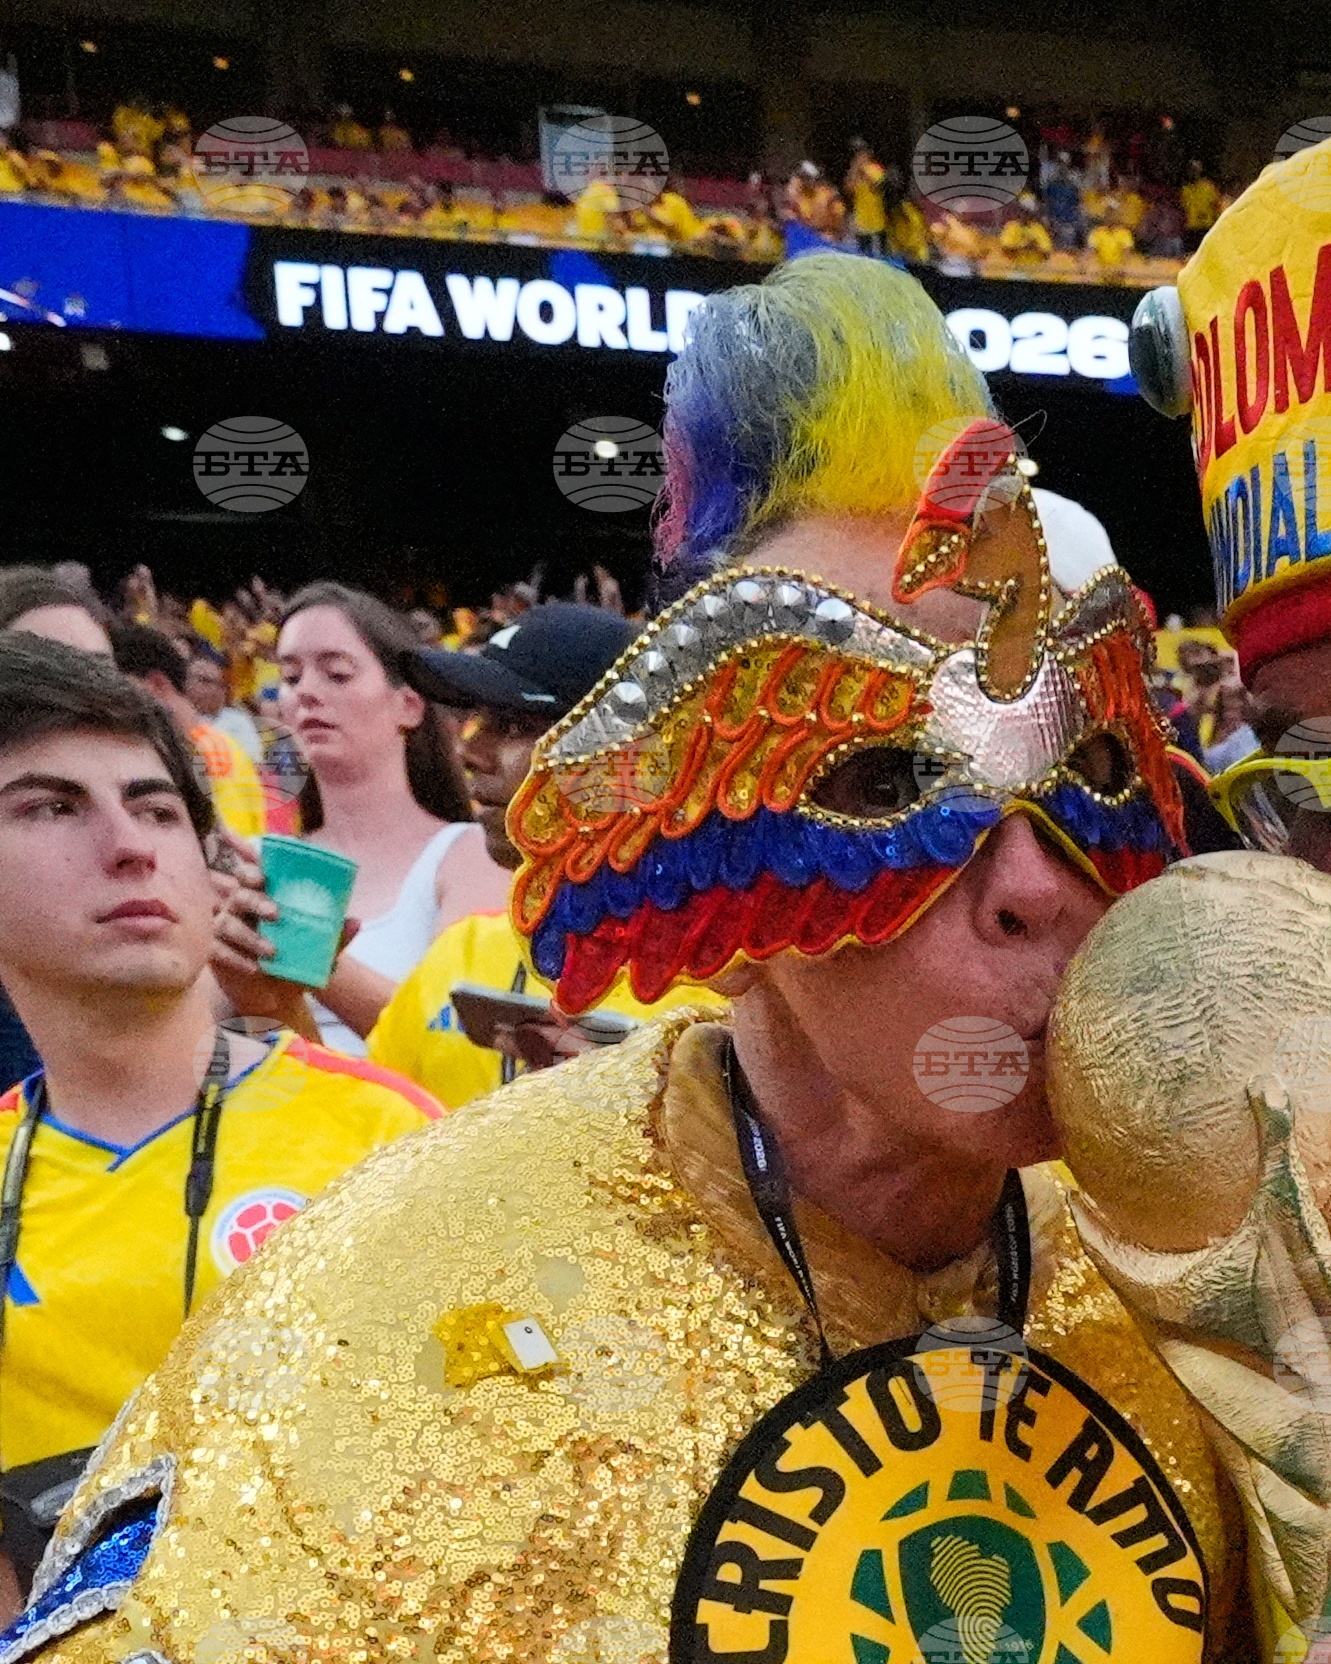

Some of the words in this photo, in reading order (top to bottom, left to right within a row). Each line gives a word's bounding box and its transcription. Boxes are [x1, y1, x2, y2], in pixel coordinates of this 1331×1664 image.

[273, 261, 445, 337] FIFA
[945, 308, 1130, 379] 026
[975, 1348, 1052, 1463] TE
[1045, 1418, 1206, 1635] AMO
